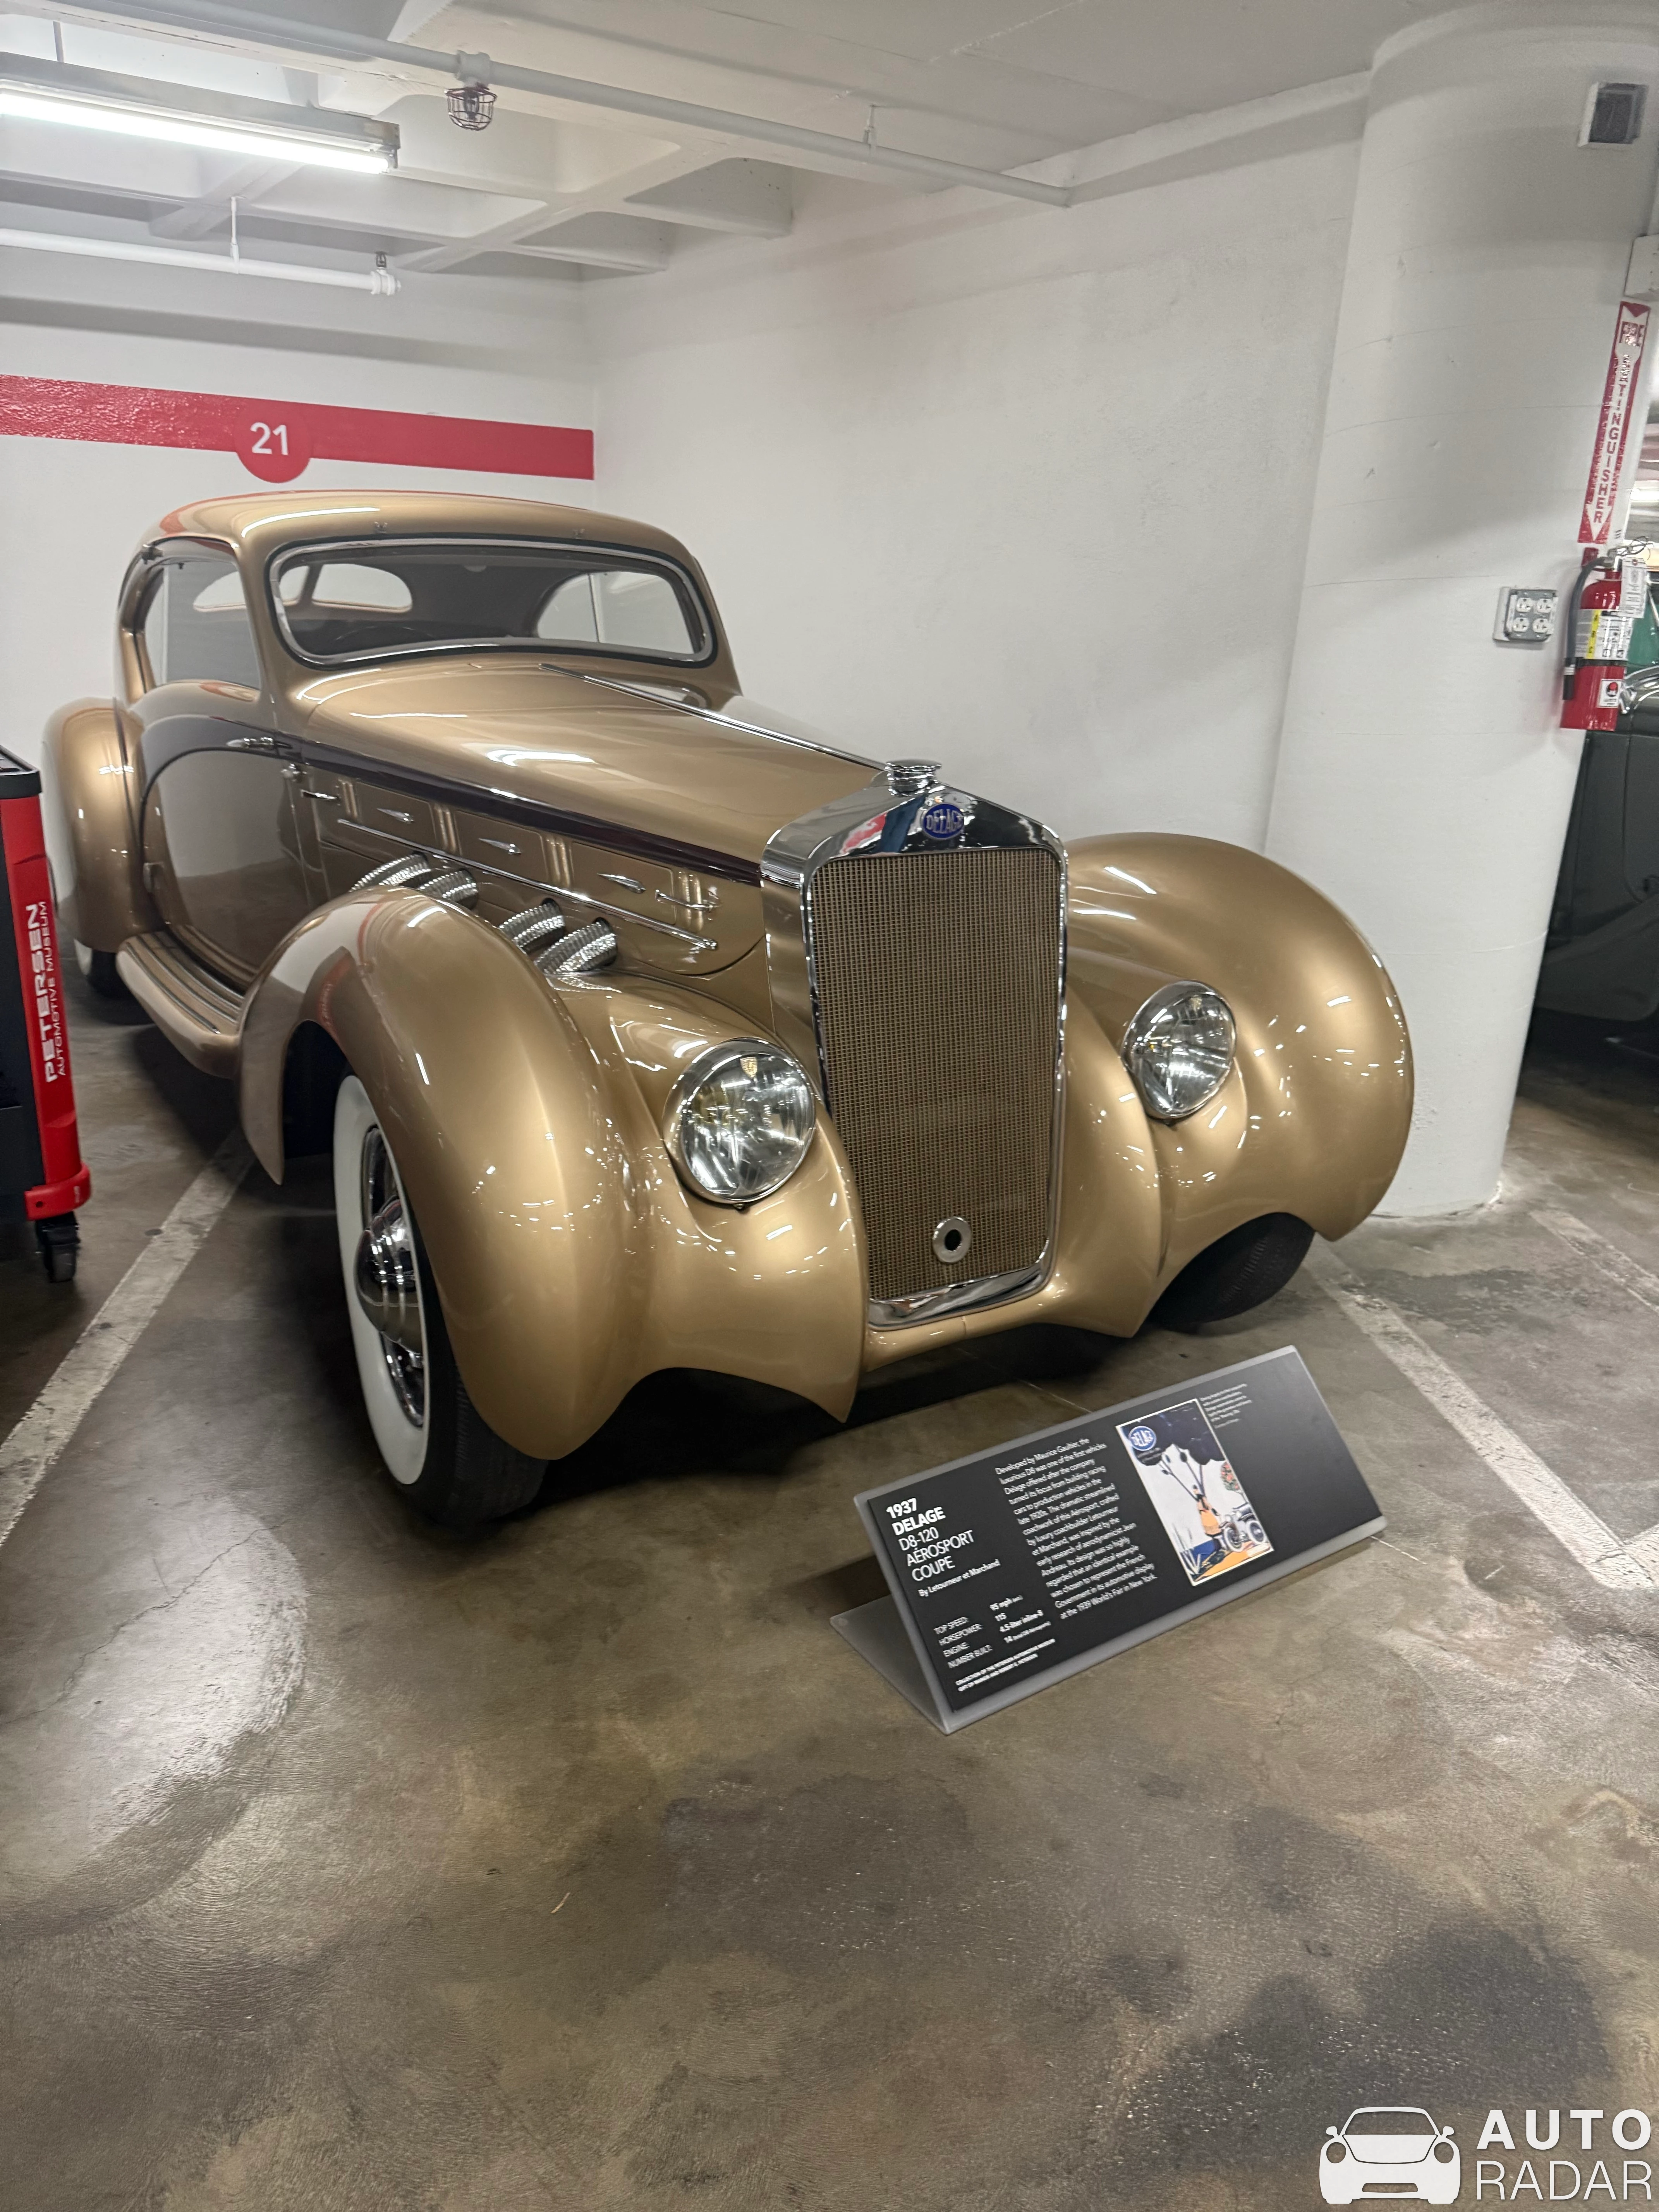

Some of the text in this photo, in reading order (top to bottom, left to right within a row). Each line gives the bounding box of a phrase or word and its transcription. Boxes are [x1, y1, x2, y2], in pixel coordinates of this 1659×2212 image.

[251, 422, 289, 456] 21
[926, 808, 962, 834] DELAGE
[26, 904, 58, 1083] PETERSEN
[38, 902, 66, 1076] AUTOMOTIVE MUSEUM
[886, 1498, 917, 1518] 1937
[891, 1506, 946, 1535] DELAGE
[898, 1527, 939, 1551] D8-120
[907, 1530, 974, 1566] AÉROSPORT
[912, 1556, 955, 1581] COUPE
[927, 1575, 962, 1592] Letourneur
[968, 1559, 1000, 1576] Marchand
[933, 1617, 969, 1634] TOP SPEED:
